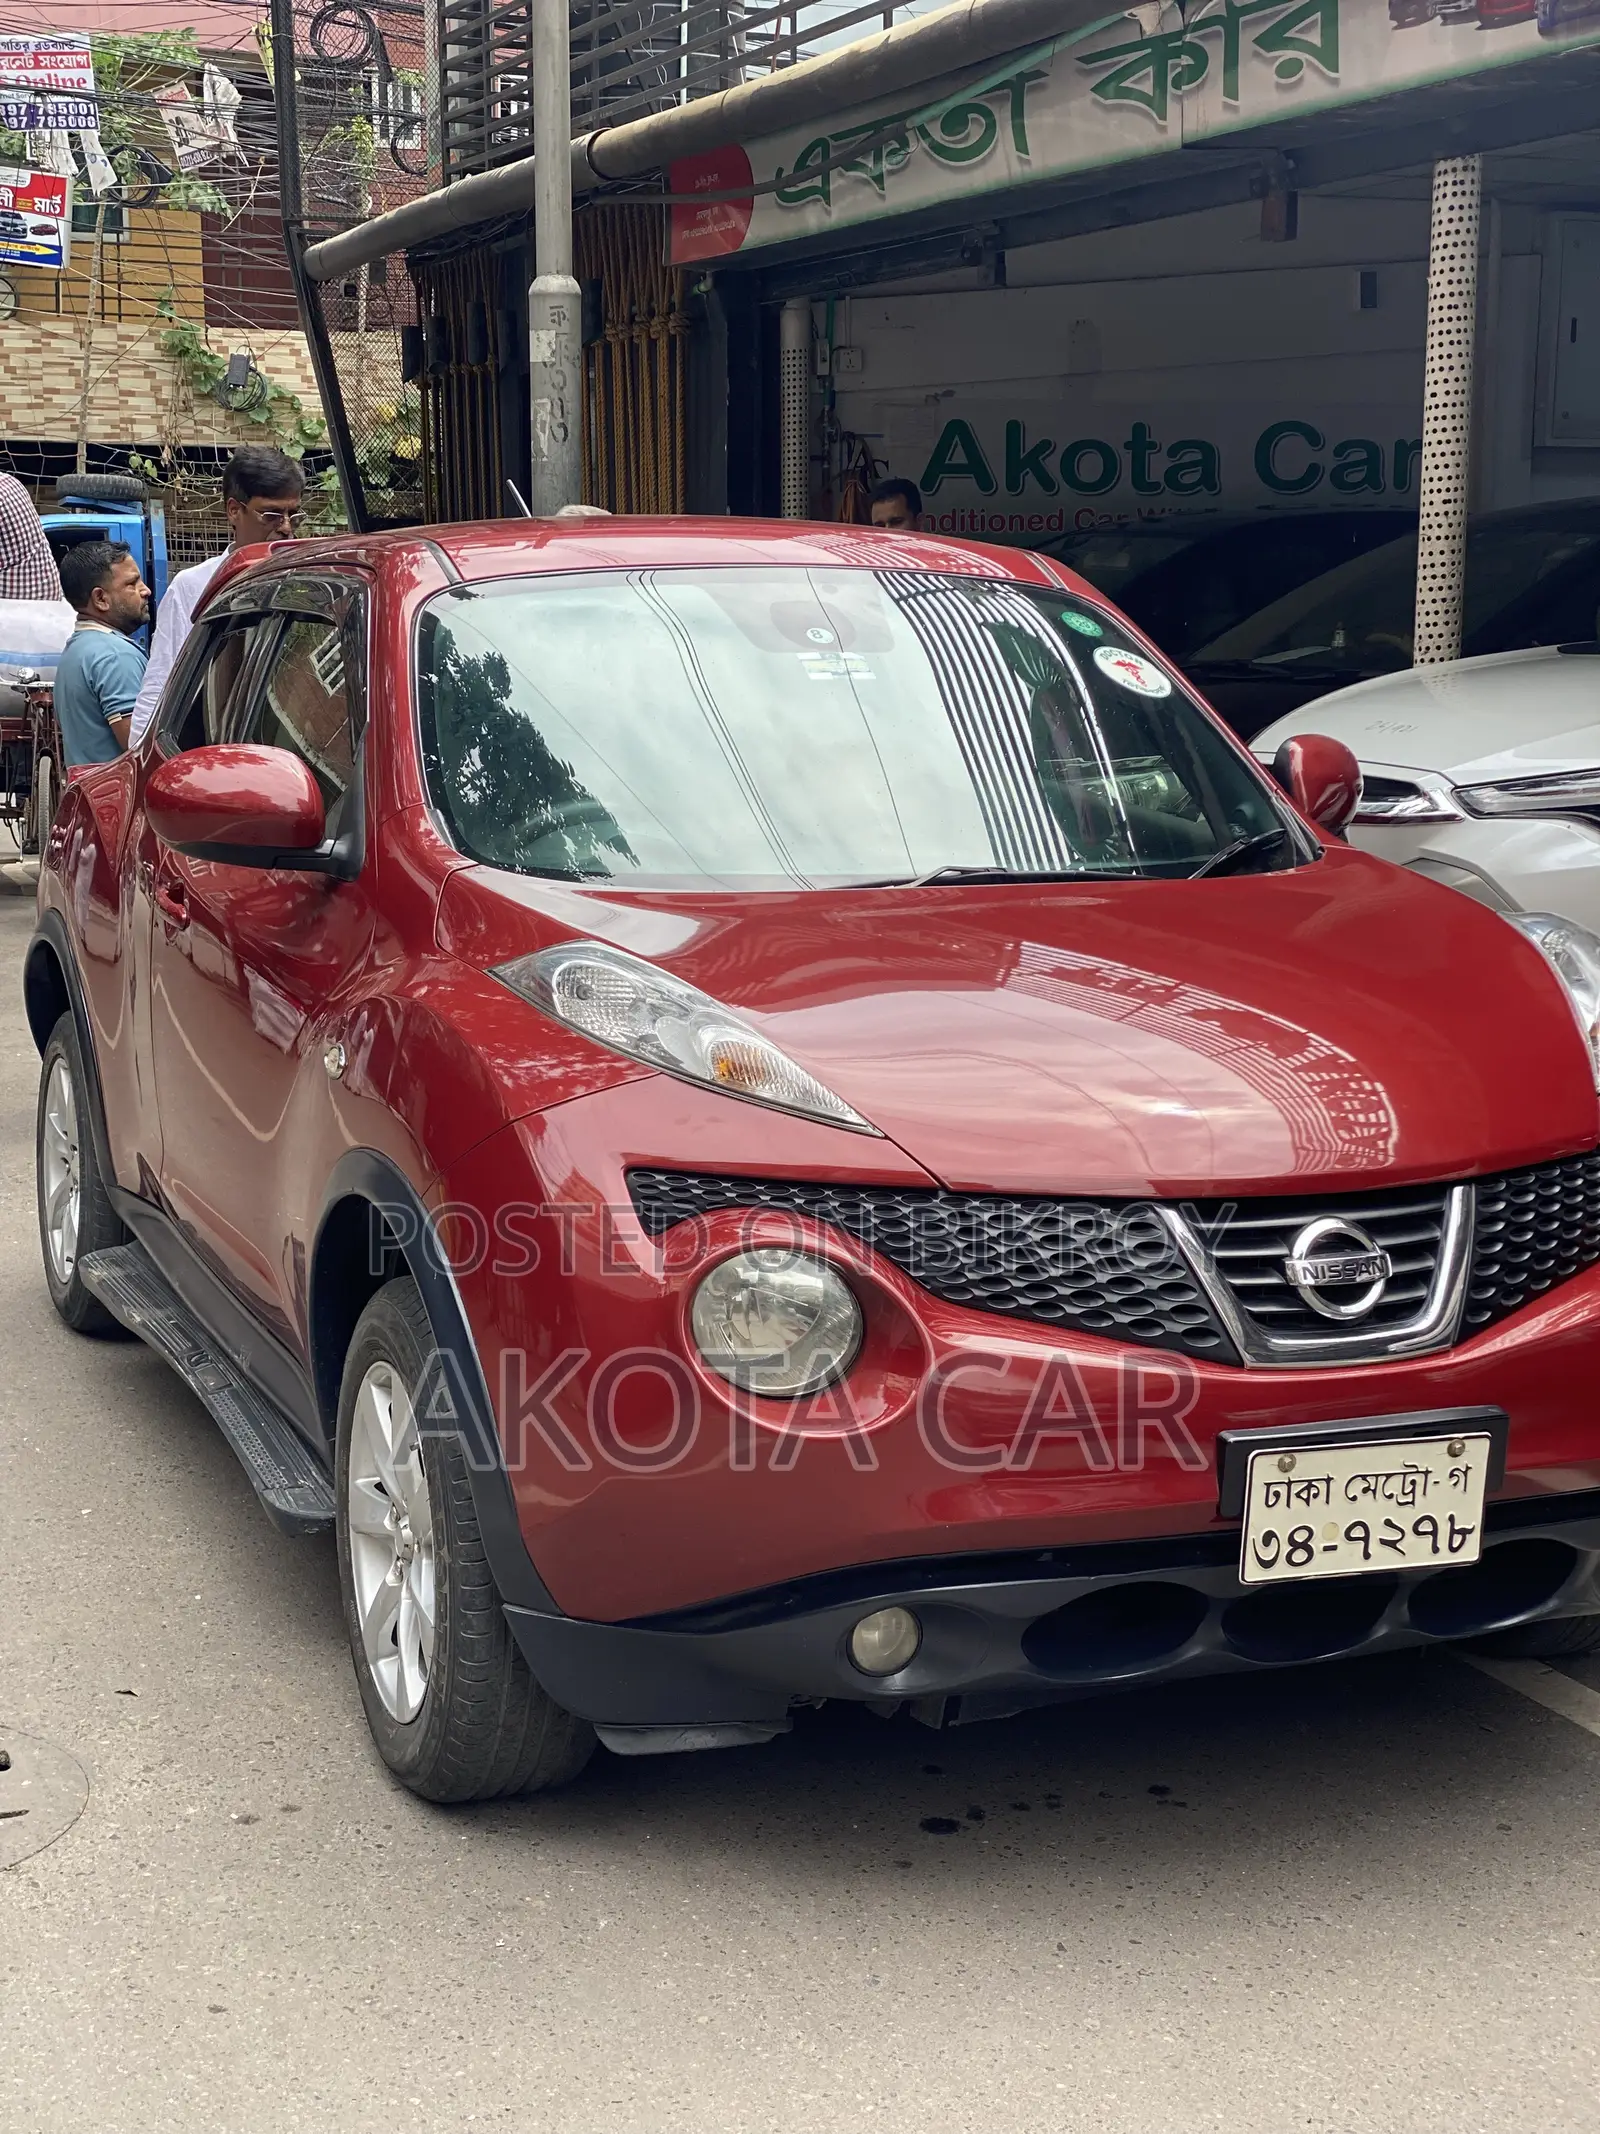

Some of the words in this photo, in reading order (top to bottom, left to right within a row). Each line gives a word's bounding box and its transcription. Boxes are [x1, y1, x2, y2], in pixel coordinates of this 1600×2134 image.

[0, 53, 35, 70] রনেট
[38, 54, 89, 69] সংযোগ
[774, 68, 1050, 210] একতা
[1074, 0, 1341, 126] কার
[919, 418, 1222, 496] Akota
[1254, 419, 1422, 496] Car
[926, 507, 1064, 532] nditioned
[1301, 1258, 1386, 1281] NISSAN
[1263, 1473, 1335, 1509] ঢাকা
[1252, 1513, 1476, 1570] ৩৪-৭২৭৮
